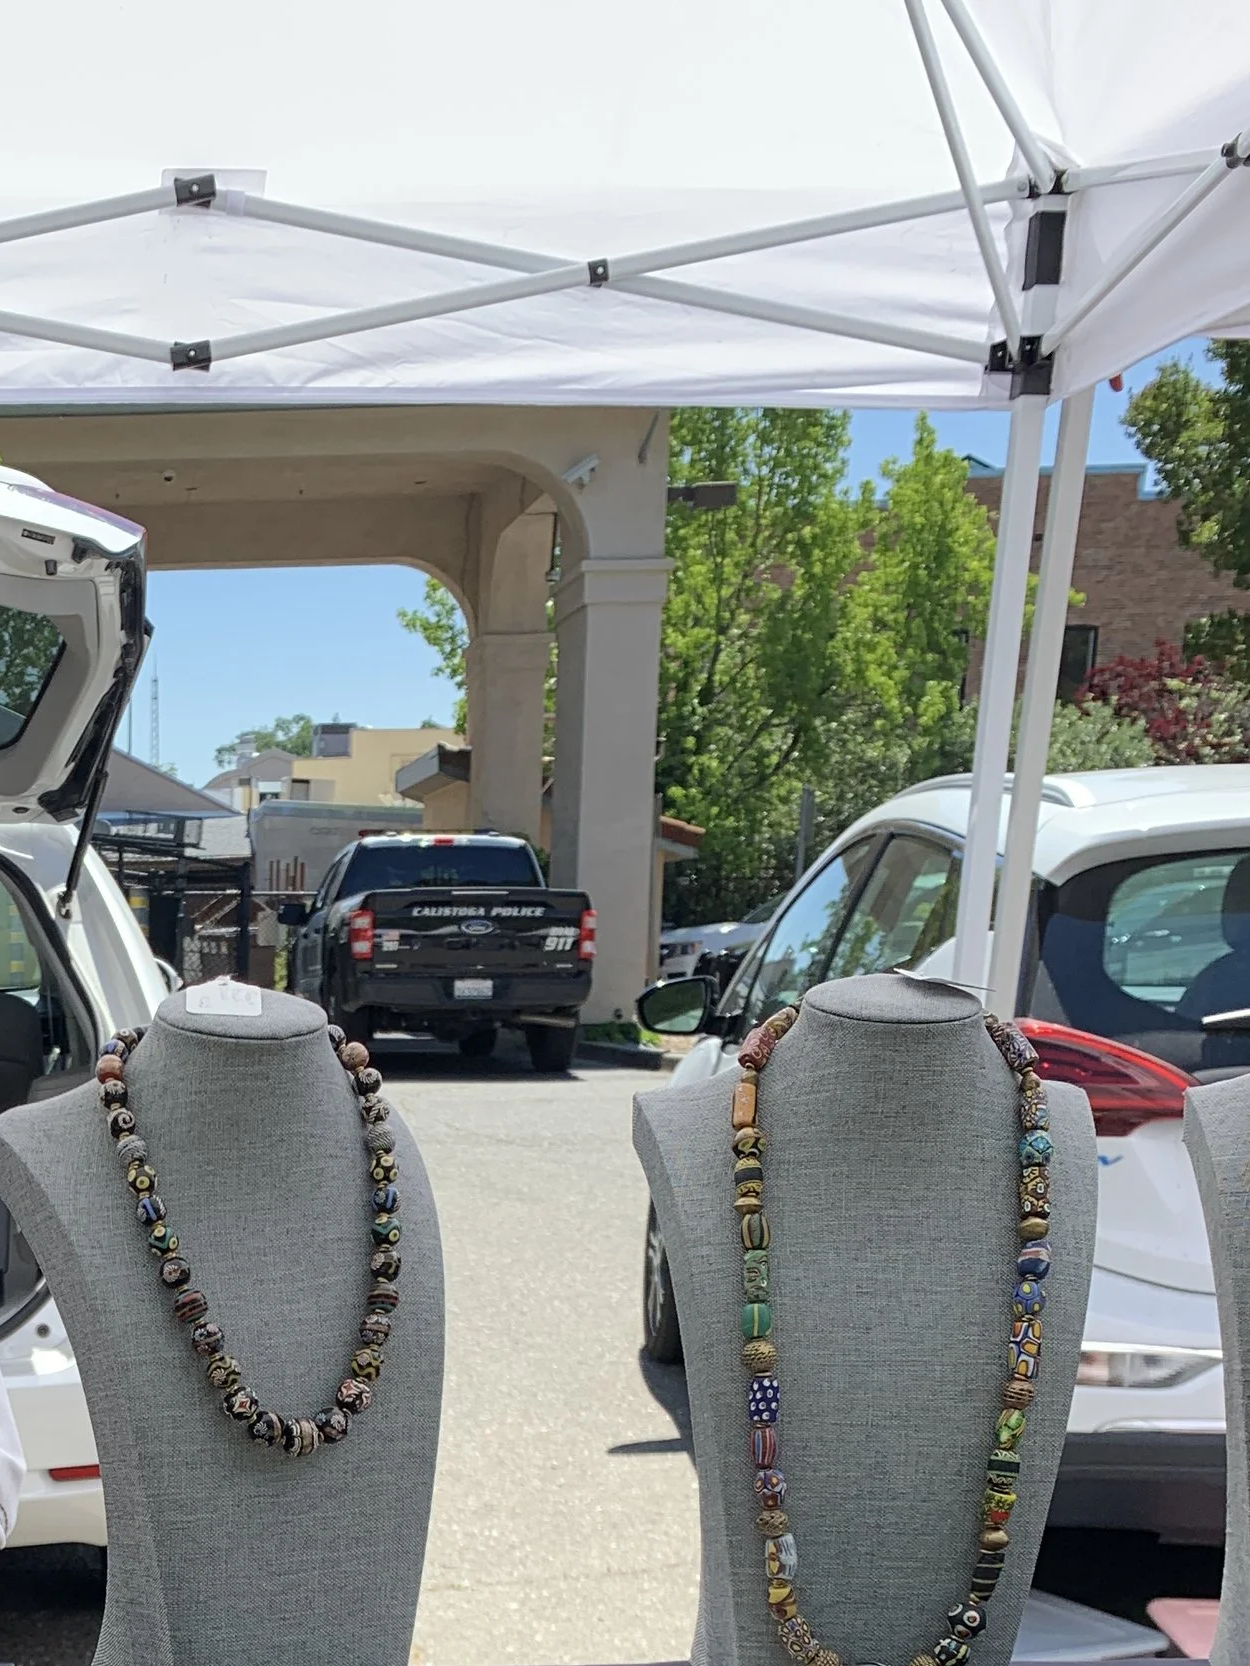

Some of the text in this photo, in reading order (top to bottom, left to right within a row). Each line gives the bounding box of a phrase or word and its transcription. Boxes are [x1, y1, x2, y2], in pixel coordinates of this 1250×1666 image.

[412, 907, 546, 917] CALISTOGA POLICE
[543, 937, 575, 951] 911
